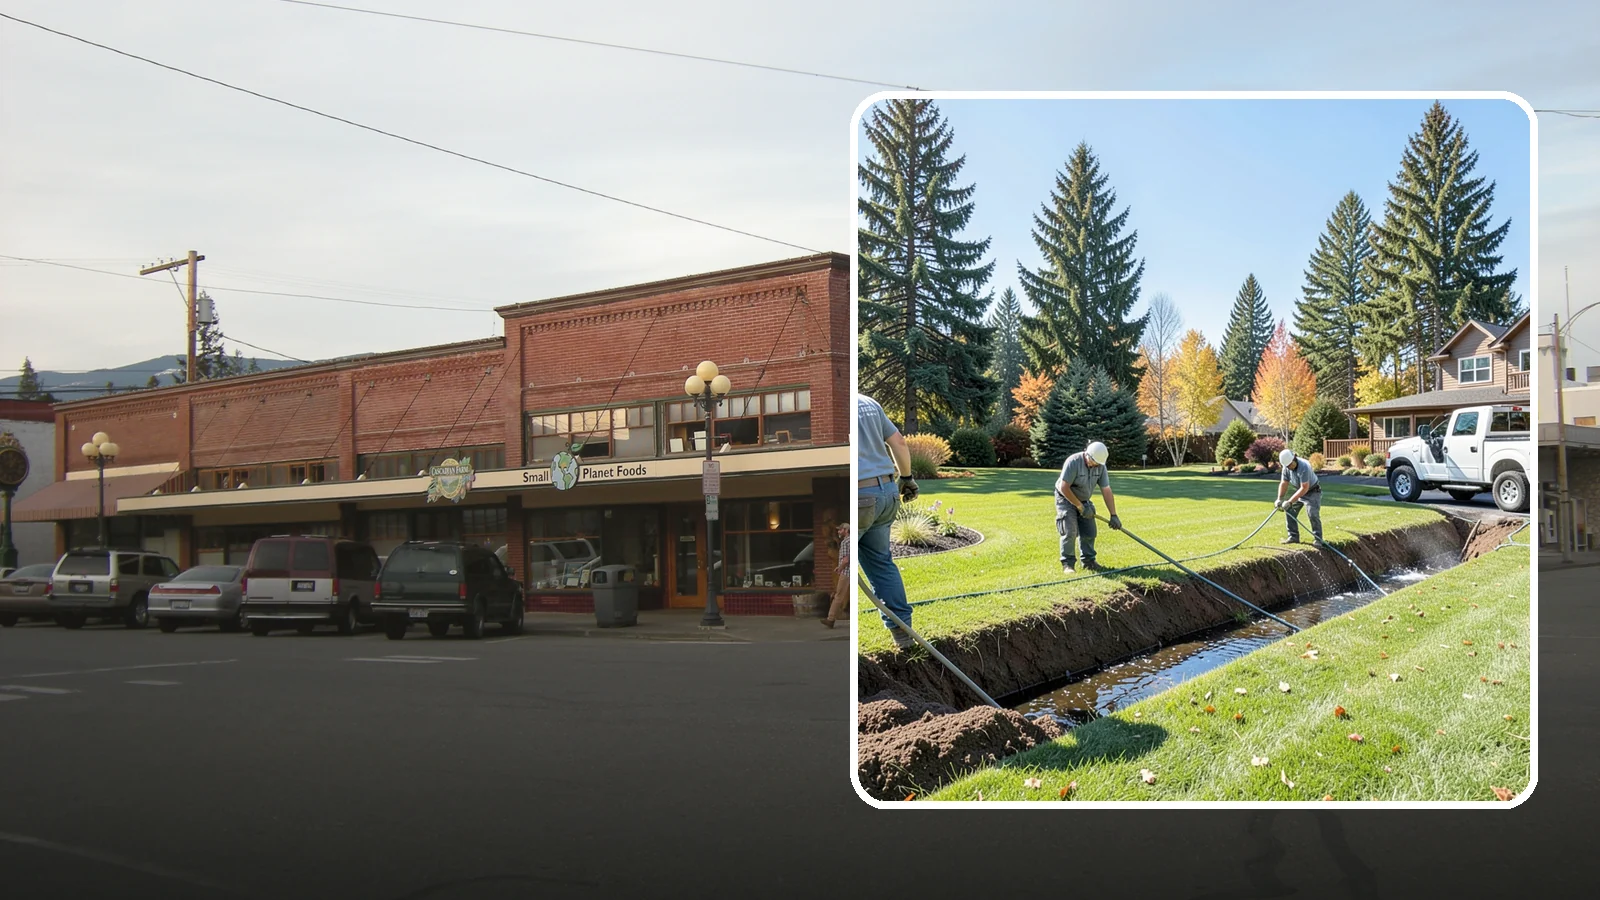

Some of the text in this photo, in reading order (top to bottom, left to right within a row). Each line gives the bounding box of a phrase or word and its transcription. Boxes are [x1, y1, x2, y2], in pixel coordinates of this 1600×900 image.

[523, 464, 647, 483] Small Planet Foods
